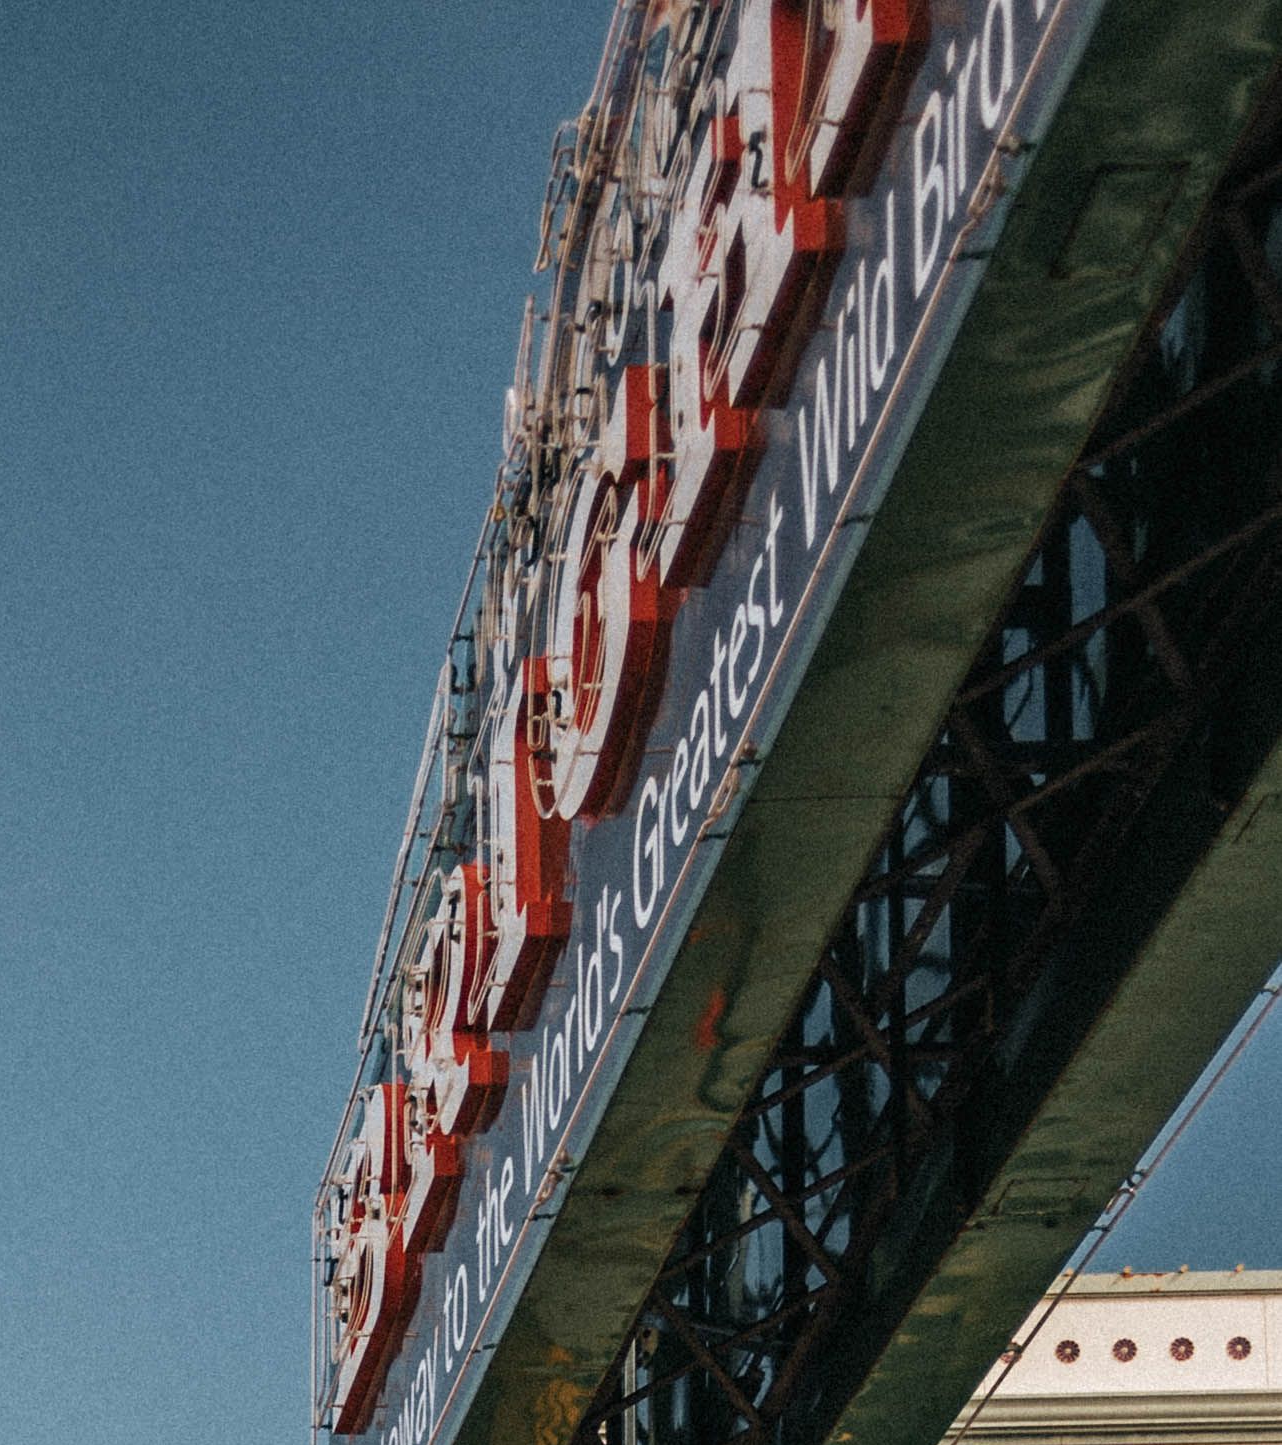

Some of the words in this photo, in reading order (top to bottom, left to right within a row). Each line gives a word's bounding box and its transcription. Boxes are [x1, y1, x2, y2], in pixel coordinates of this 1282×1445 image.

[445, 1263, 468, 1374] to
[477, 1156, 514, 1303] the
[521, 883, 623, 1196] World's
[632, 486, 784, 930] Greatest
[799, 189, 895, 550] Wild
